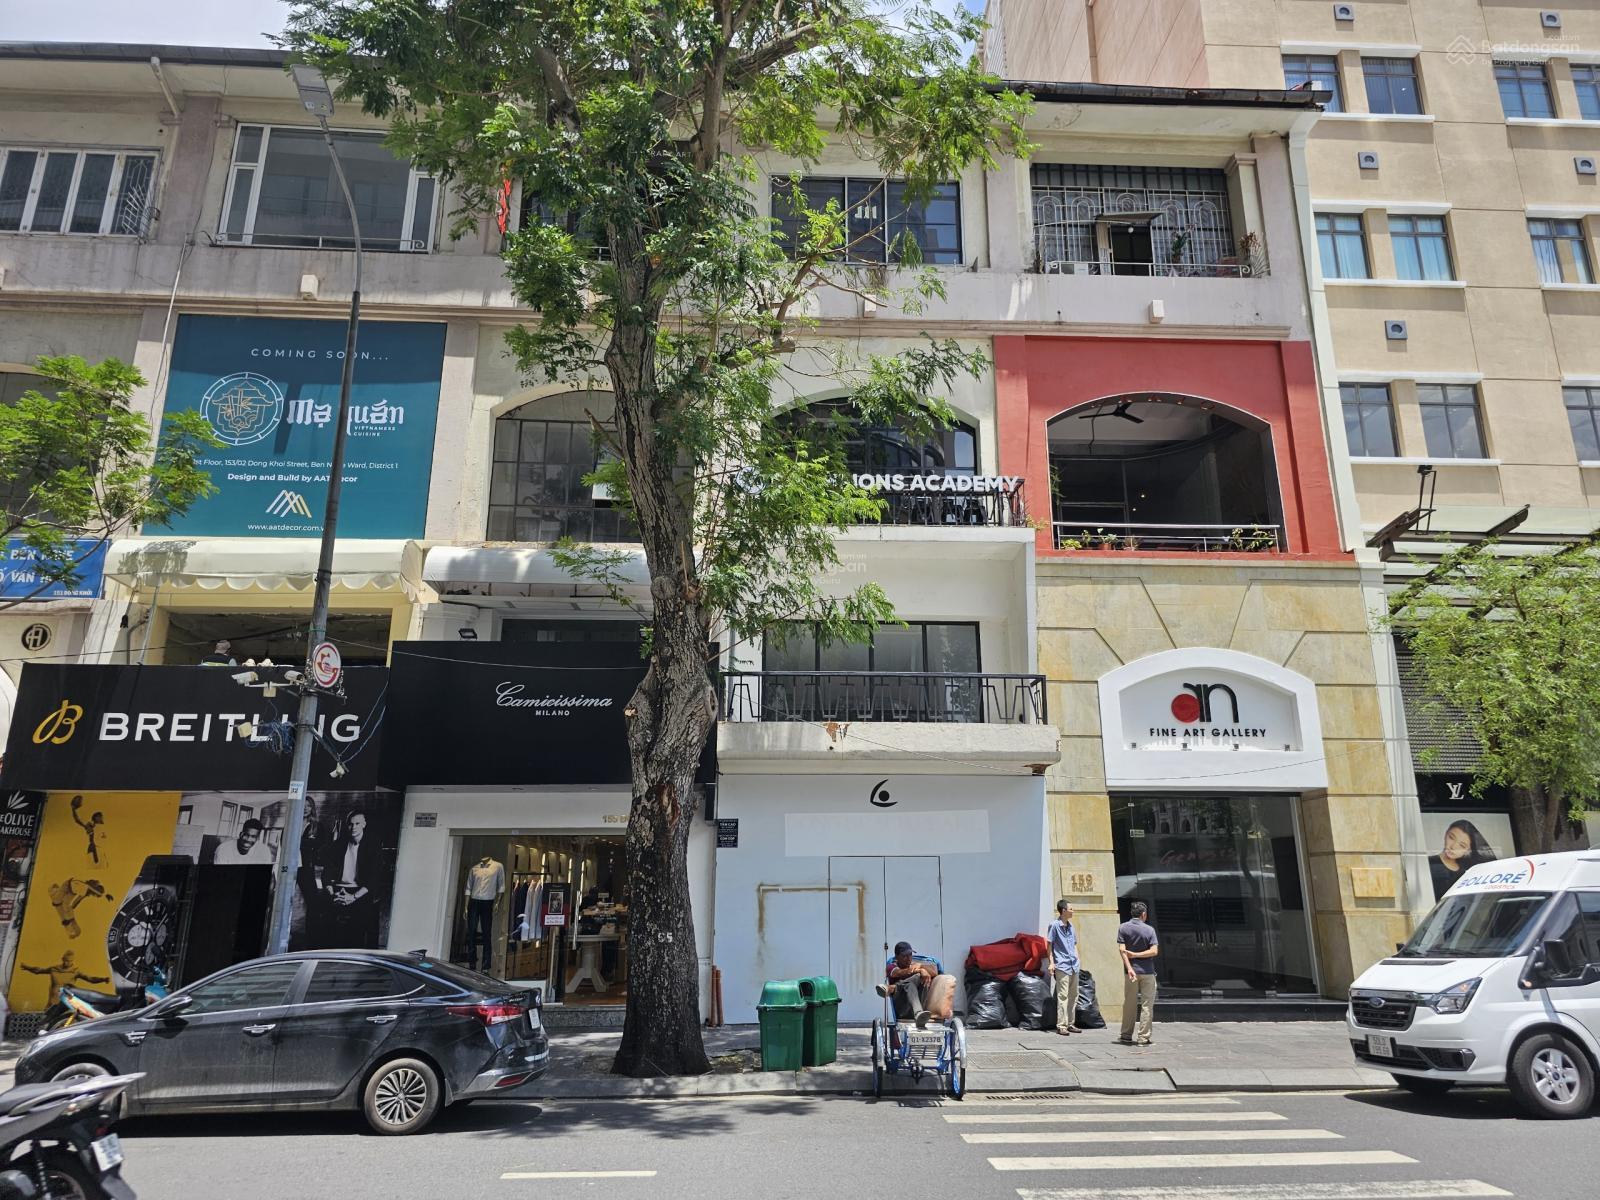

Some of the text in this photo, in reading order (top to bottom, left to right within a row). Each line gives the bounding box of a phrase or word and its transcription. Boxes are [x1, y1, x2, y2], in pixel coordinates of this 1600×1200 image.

[251, 348, 316, 359] COMING
[203, 459, 224, 467] Floor,
[247, 460, 268, 468] Dong
[286, 461, 310, 469] Street,
[227, 473, 257, 482] Design
[301, 475, 312, 483] by
[910, 474, 1020, 493] ACADEMY
[247, 524, 325, 532] www.aatdecor.com.v
[495, 681, 613, 707] Camicissima
[99, 712, 361, 743] BREITLG
[1149, 727, 1267, 738] FINE ART GALLERY
[4, 812, 35, 827] OLIVE
[0, 825, 32, 836] AKHOUSE
[1457, 870, 1528, 889] BOLLORÉ
